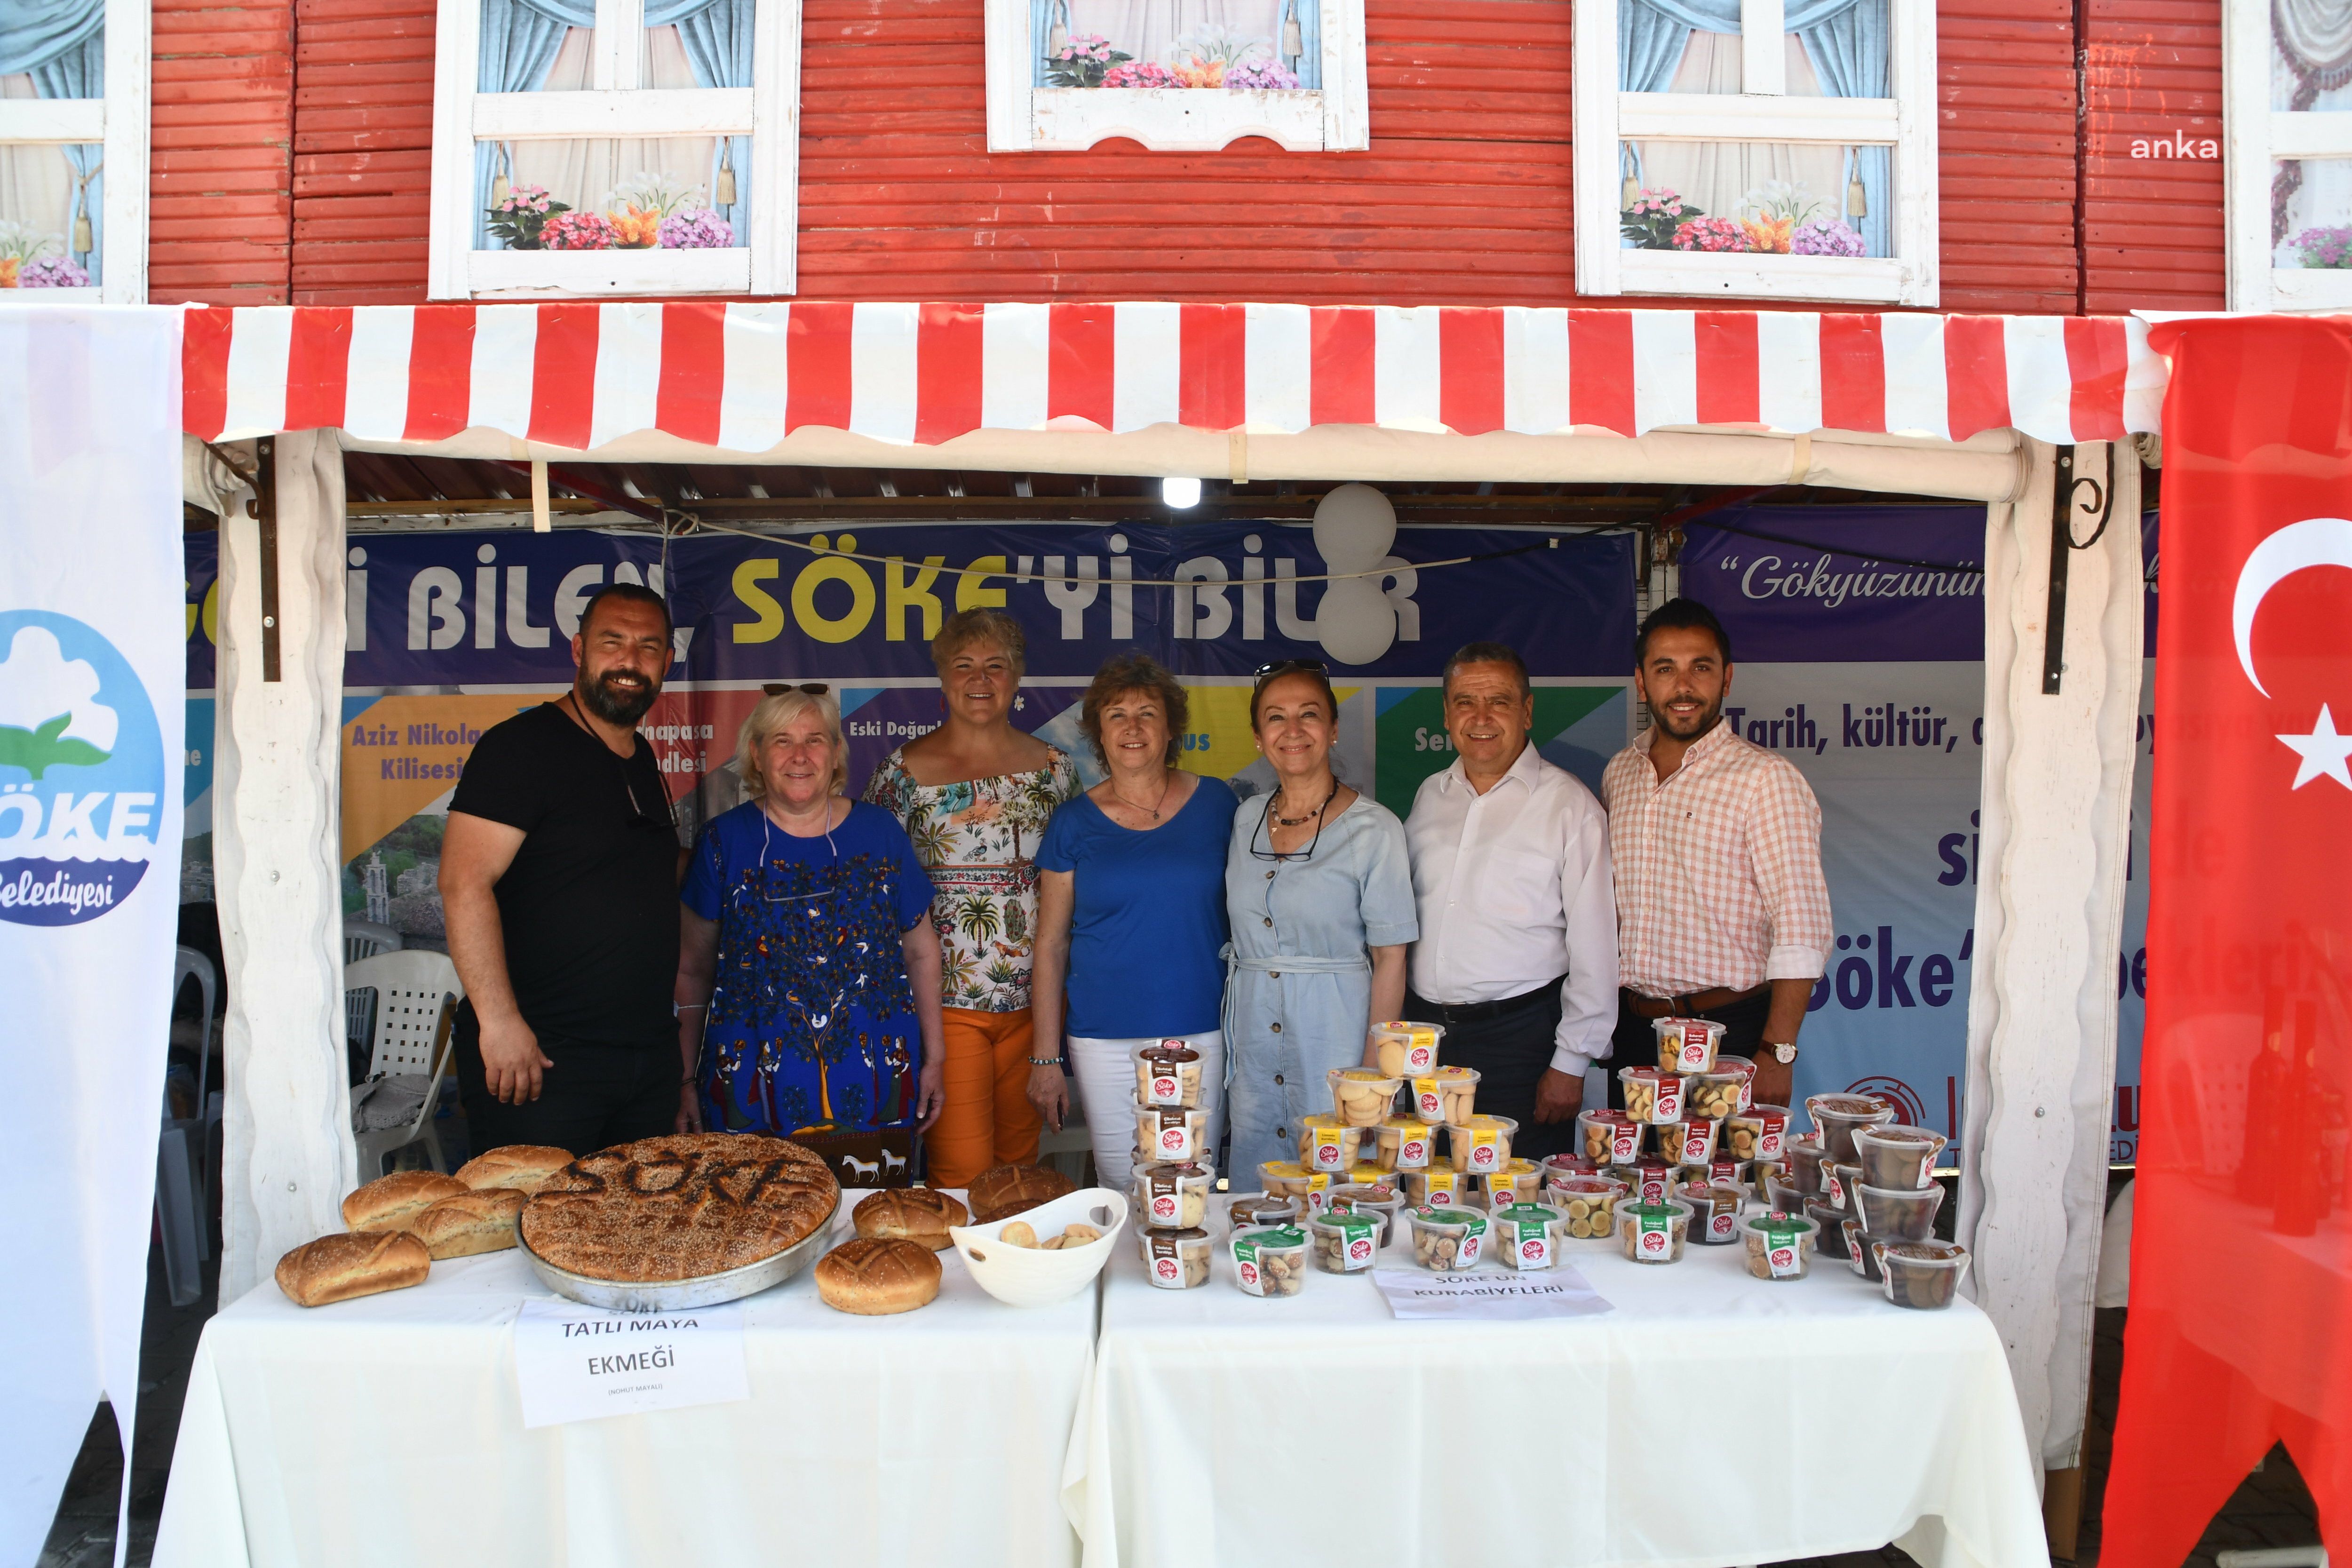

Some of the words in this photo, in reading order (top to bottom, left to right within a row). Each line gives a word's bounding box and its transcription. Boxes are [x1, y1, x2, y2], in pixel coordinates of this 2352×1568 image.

[1173, 534, 1420, 641] BİLR
[352, 724, 398, 746] Aziz
[407, 723, 489, 745] Nikola
[850, 721, 872, 736] Eski
[1843, 703, 1958, 753] kültür,
[381, 756, 463, 780] Kilisesi
[0, 783, 156, 842] ÖKE
[0, 870, 113, 915] elediyesi
[562, 1321, 622, 1337] TATLI
[629, 1319, 699, 1332] MAYA
[588, 1345, 675, 1375] EKMEĞİ
